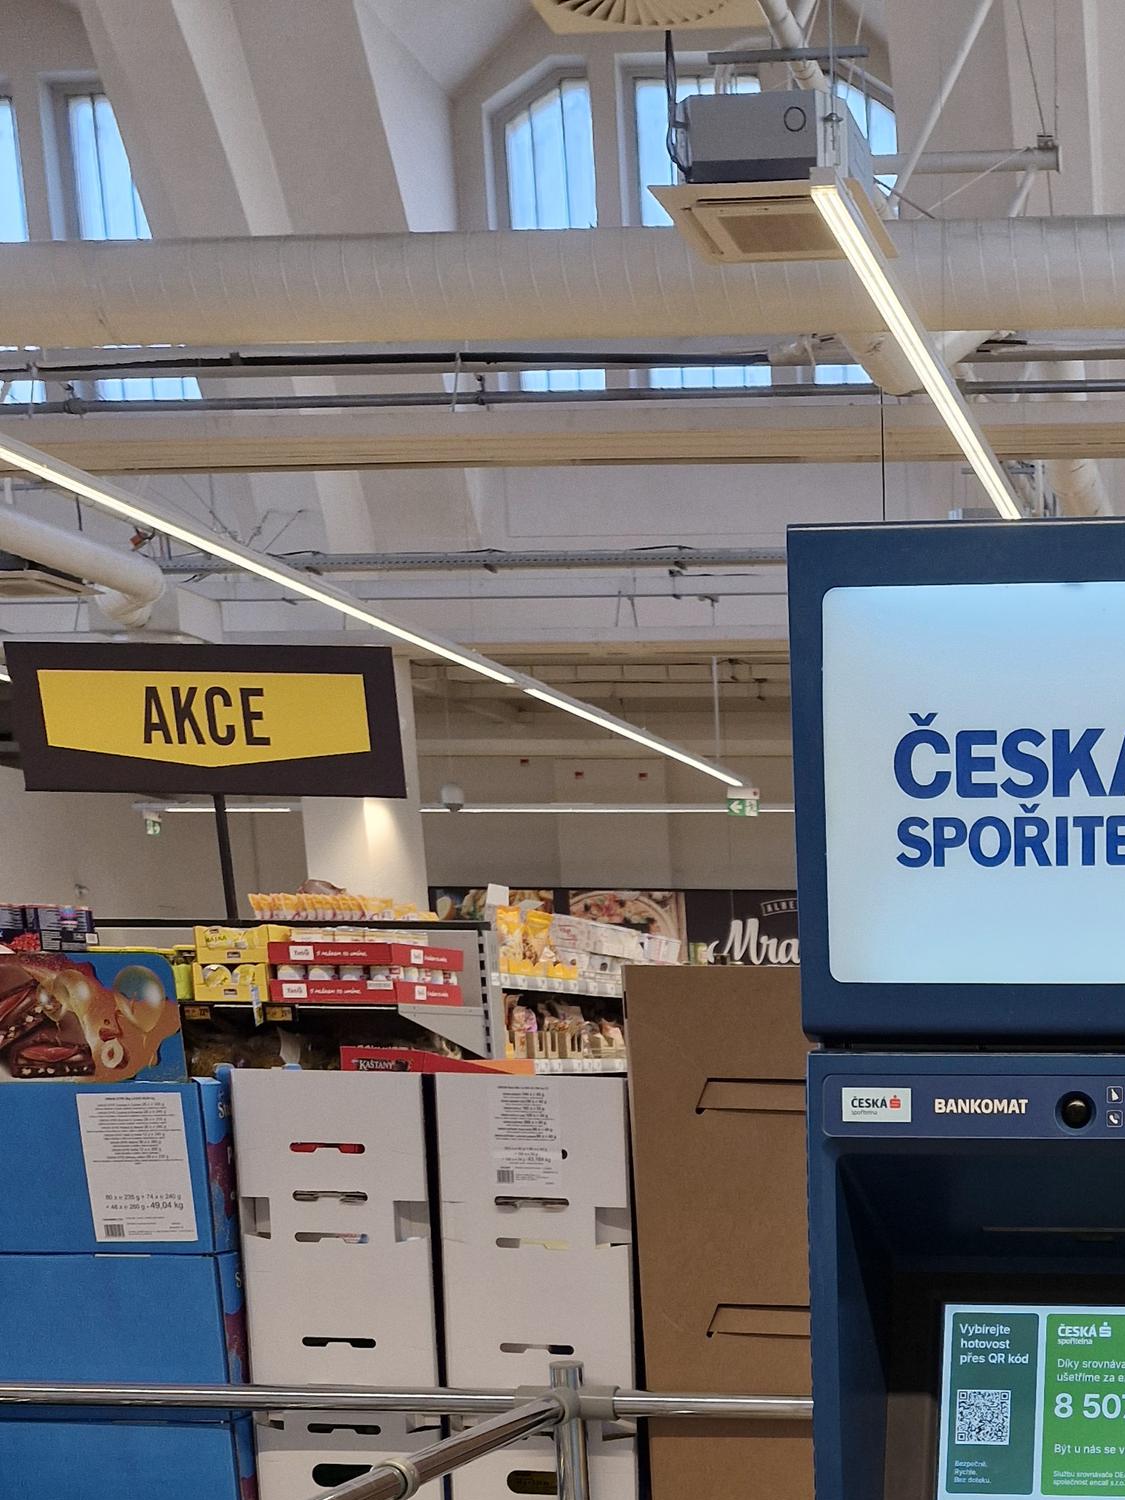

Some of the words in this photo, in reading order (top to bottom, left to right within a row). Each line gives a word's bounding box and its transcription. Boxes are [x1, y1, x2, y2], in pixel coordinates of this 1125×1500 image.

[143, 686, 271, 747] AKCE
[359, 1059, 394, 1071] KAŠTANY
[851, 1095, 888, 1109] ČESKÁ
[934, 1098, 1028, 1114] BANKOMAT
[150, 1201, 172, 1210] 49,04
[174, 1201, 184, 1211] kg
[959, 1323, 1011, 1337] Vybírejte
[1057, 1323, 1097, 1337] ČESKÁ
[960, 1338, 1010, 1349] hotovost
[1057, 1337, 1093, 1345] spořitelna
[959, 1352, 986, 1365] přes
[988, 1353, 1005, 1363] QR
[1008, 1353, 1029, 1363] kód
[1057, 1359, 1079, 1370] Díky
[1056, 1373, 1100, 1382] ušetříme
[1053, 1392, 1073, 1418] 8
[1054, 1443, 1071, 1455] Být
[1084, 1444, 1101, 1454] nás
[1104, 1446, 1116, 1454] se
